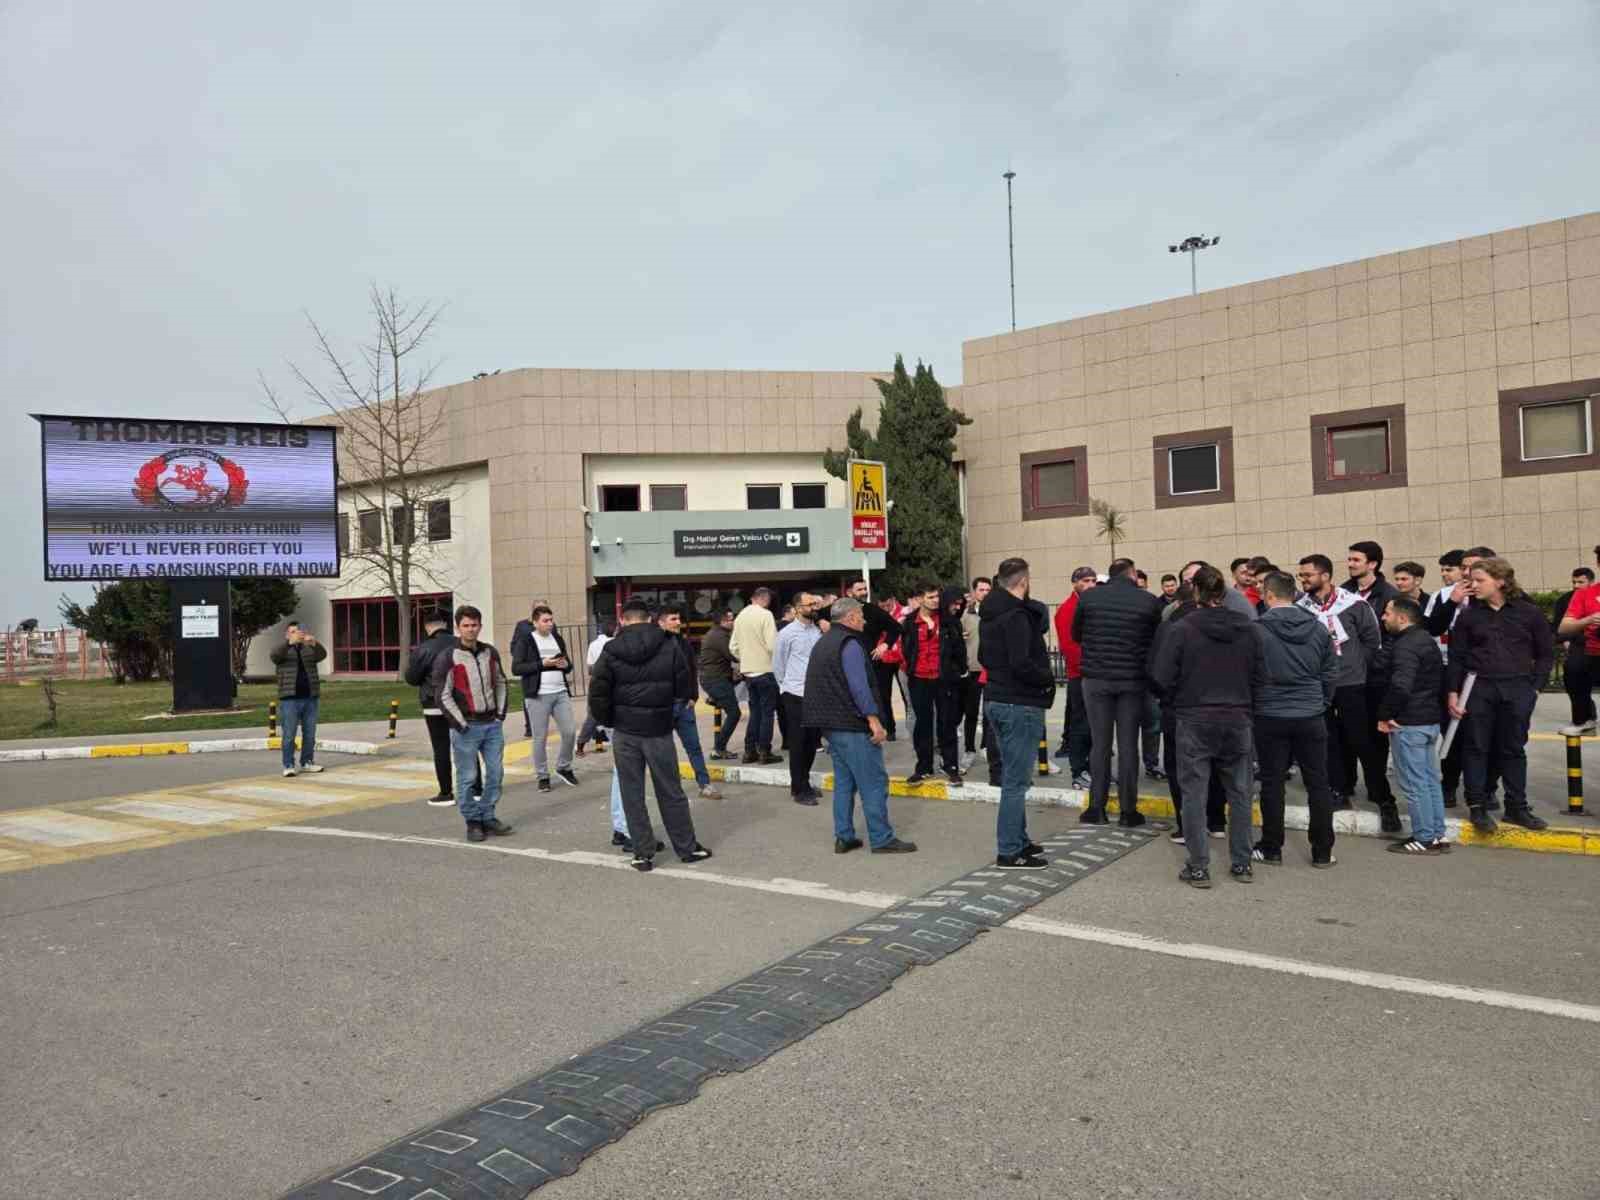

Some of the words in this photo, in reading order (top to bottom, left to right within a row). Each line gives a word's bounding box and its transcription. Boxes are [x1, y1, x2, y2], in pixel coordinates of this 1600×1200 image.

[91, 521, 159, 535] THANKS
[165, 521, 196, 535] FOR
[200, 521, 301, 535] EVERYTHING
[88, 542, 141, 556] WE'LL
[146, 542, 201, 556] NEVER
[206, 542, 266, 556] FORGET
[271, 542, 303, 556] YOU
[48, 563, 84, 577] YOU
[90, 563, 123, 577] ARE
[129, 563, 141, 577] A
[146, 562, 259, 577] SAMSUNSPOR
[263, 561, 293, 576] FAN
[298, 561, 333, 576] NOW
